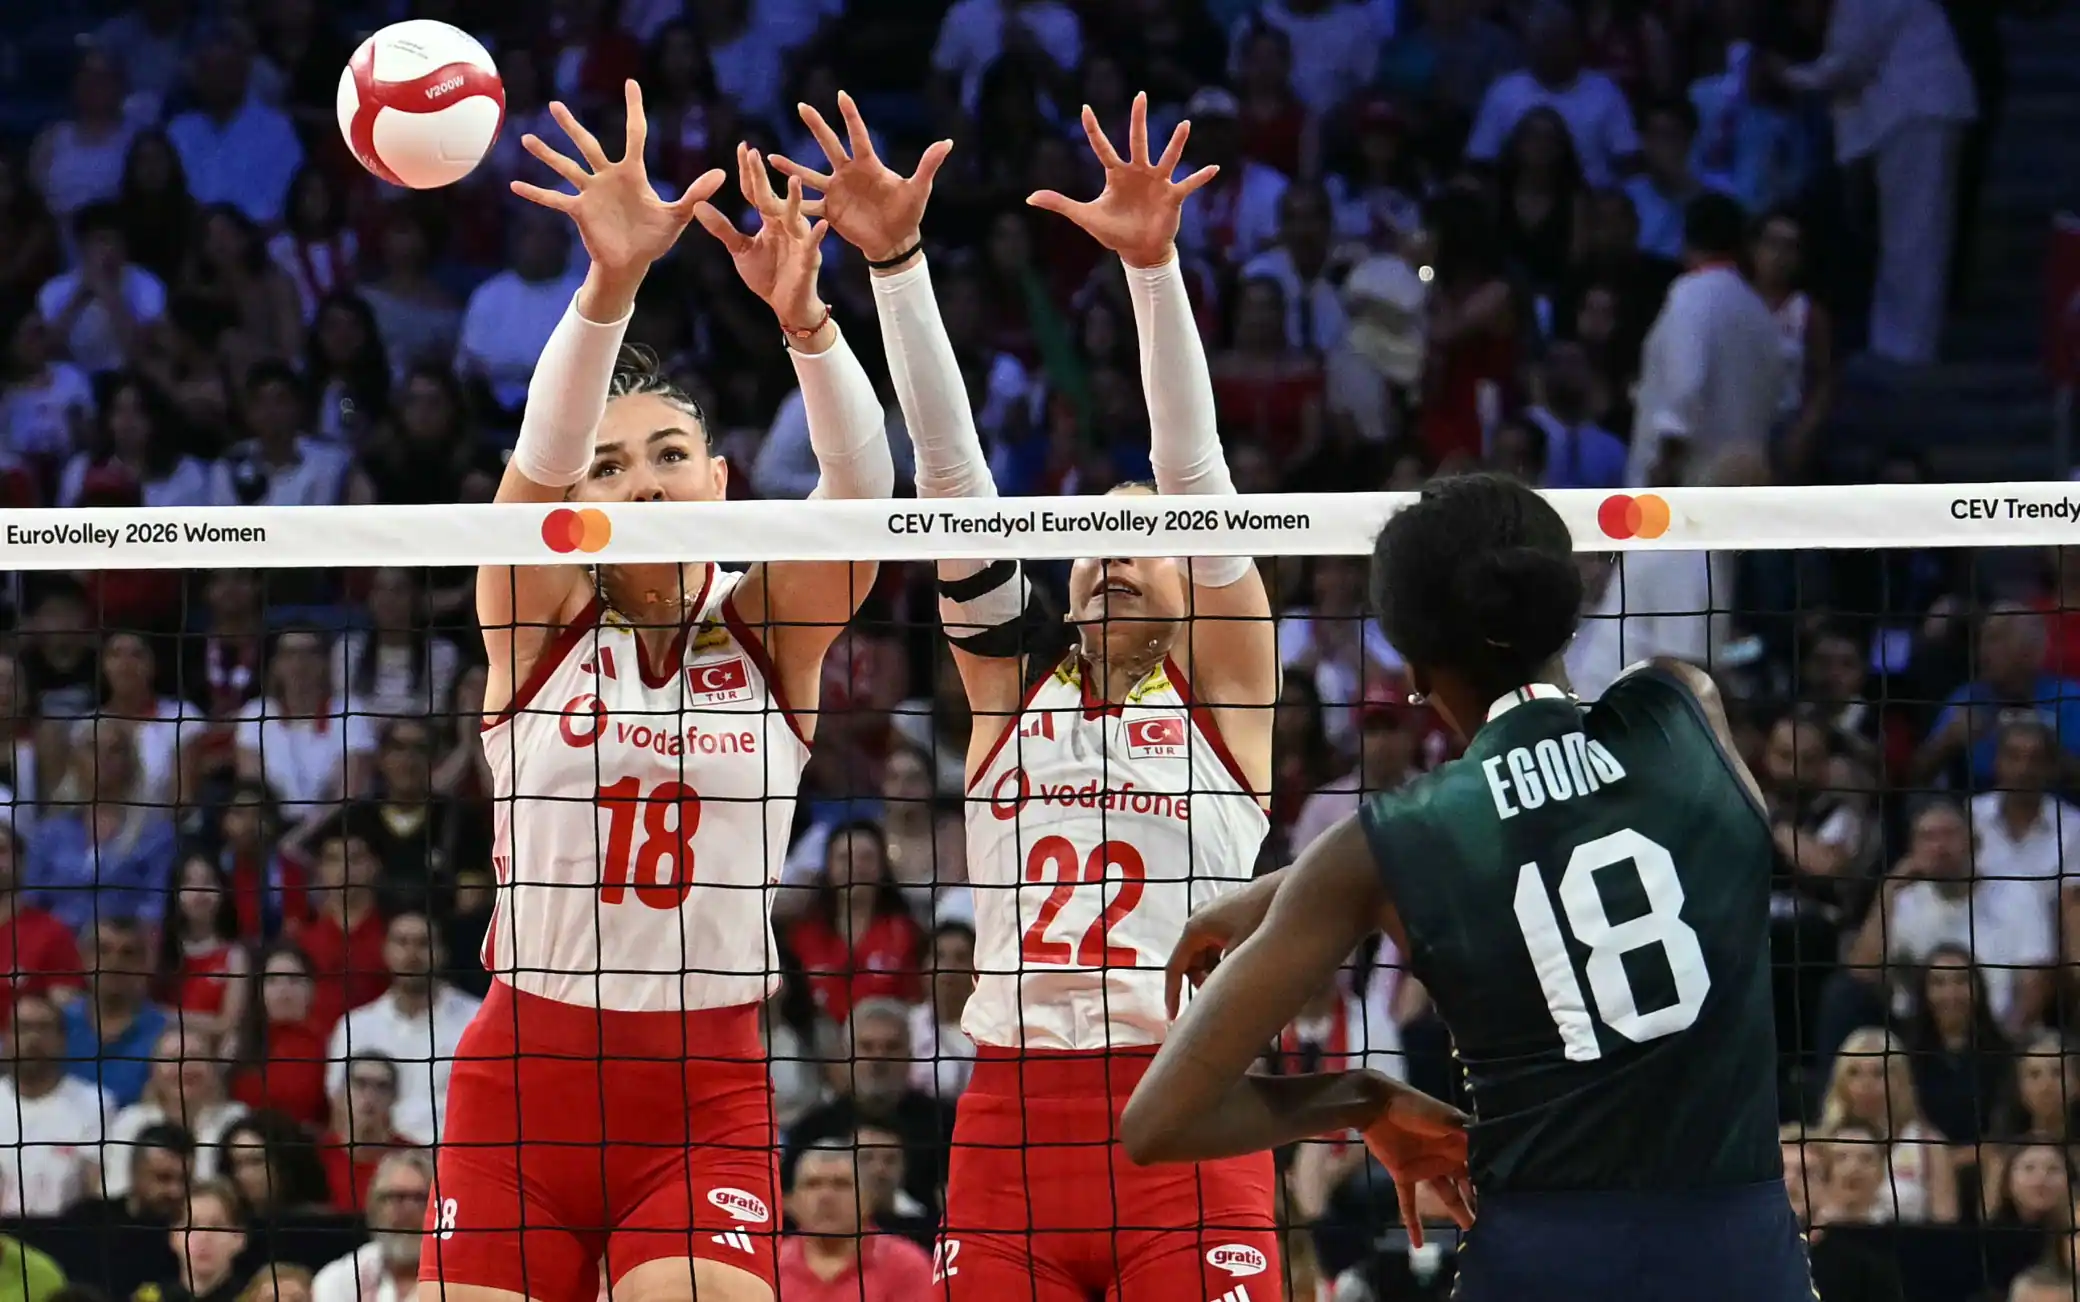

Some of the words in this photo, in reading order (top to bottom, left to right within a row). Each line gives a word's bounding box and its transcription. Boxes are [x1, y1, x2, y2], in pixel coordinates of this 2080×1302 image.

[425, 75, 465, 100] V200W
[1951, 499, 1998, 519] CEV
[2004, 497, 2080, 523] Trendy
[8, 523, 119, 548] EuroVolley
[126, 523, 177, 543] 2026
[184, 523, 265, 542] Women
[888, 514, 934, 533] CEV
[939, 512, 1034, 537] Trendyol
[1042, 510, 1158, 536] EuroVolley
[1165, 510, 1218, 530] 2026
[1224, 510, 1309, 529] Women
[706, 691, 737, 702] TUR
[617, 722, 756, 756] vodafone
[1143, 746, 1175, 755] TUR
[1040, 779, 1191, 821] vodafone
[596, 776, 702, 909] 18
[1022, 835, 1146, 968] 22
[1514, 828, 1711, 1062] 18
[716, 1192, 765, 1216] gratis
[932, 1239, 961, 1286] 22
[1214, 1250, 1262, 1266] gratis
